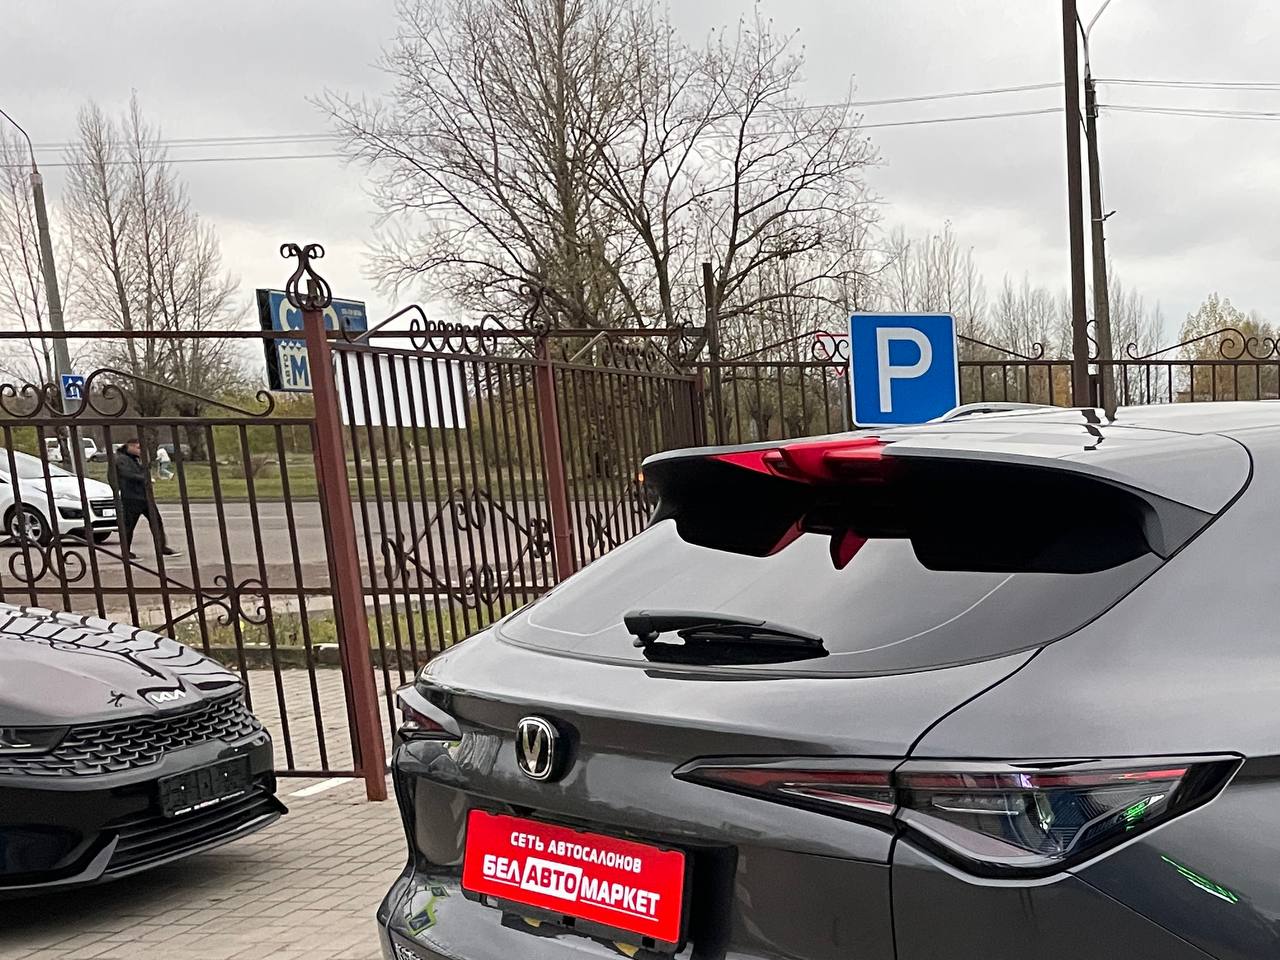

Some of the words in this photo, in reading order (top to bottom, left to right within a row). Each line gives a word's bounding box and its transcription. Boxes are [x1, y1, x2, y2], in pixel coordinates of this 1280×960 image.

[876, 327, 933, 413] P
[510, 831, 545, 851] СЕТЬ
[547, 839, 642, 874] АВТОСАЛОНОВ
